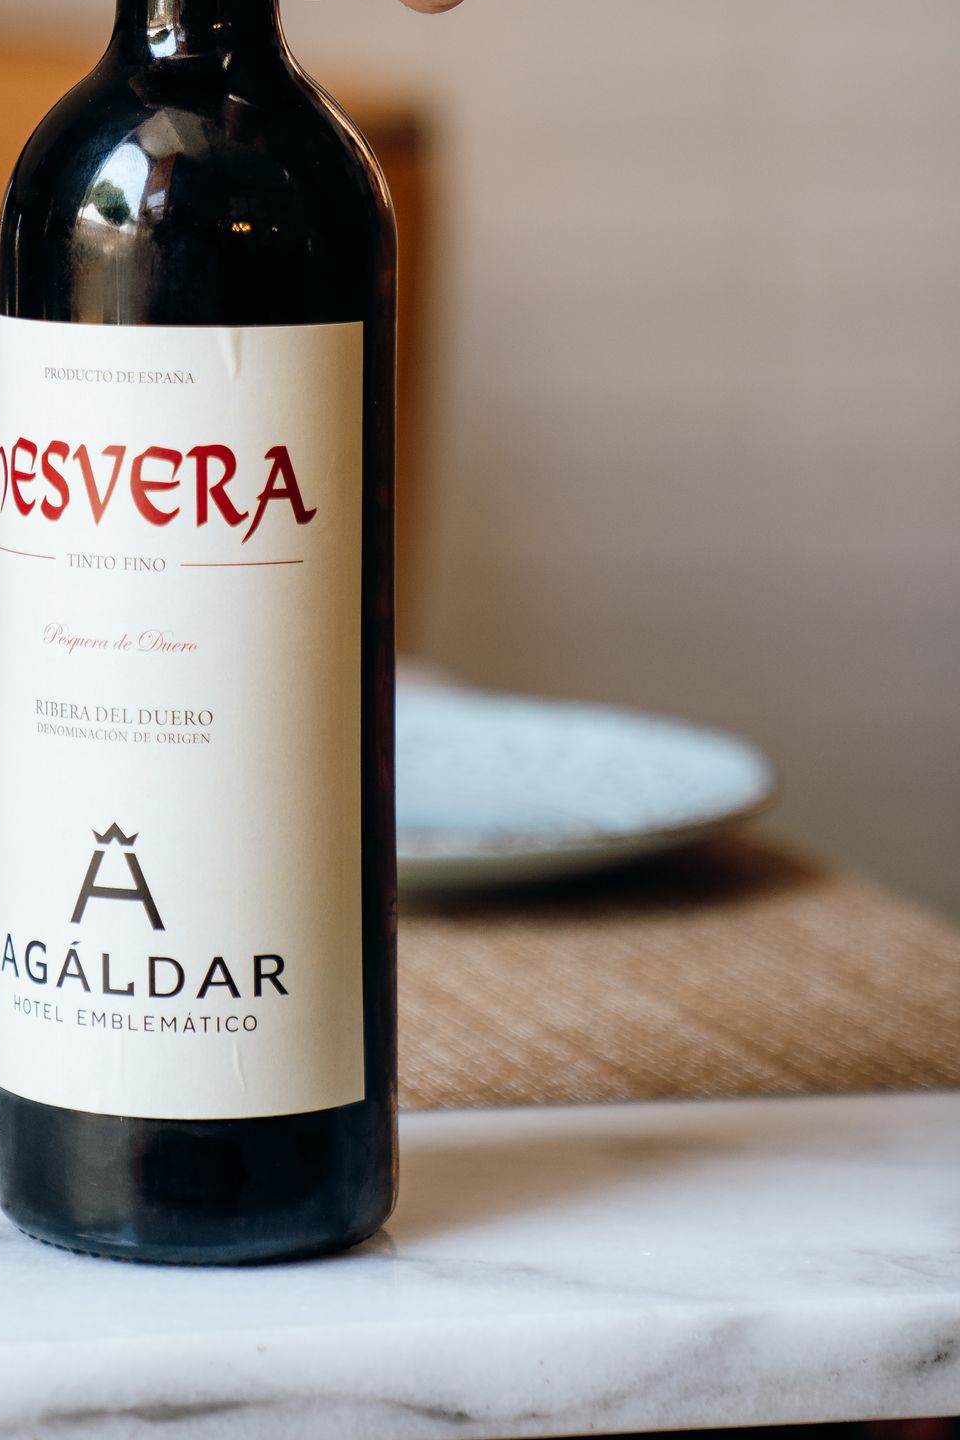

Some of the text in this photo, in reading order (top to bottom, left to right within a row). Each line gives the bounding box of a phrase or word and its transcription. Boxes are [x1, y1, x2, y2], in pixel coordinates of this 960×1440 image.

[44, 367, 196, 384] PRODUCTO DE ESPAÑA
[66, 553, 166, 572] TINTO FINO
[43, 622, 198, 654] Pesquera de Duero
[36, 700, 213, 726] RIBERA DEL DUERO
[37, 722, 211, 745] DENOMINACIÓN DE ORIGEN
[1, 933, 289, 999] AGÁLDAR
[13, 994, 258, 1034] HOTEL EMBLEMÁTICO
